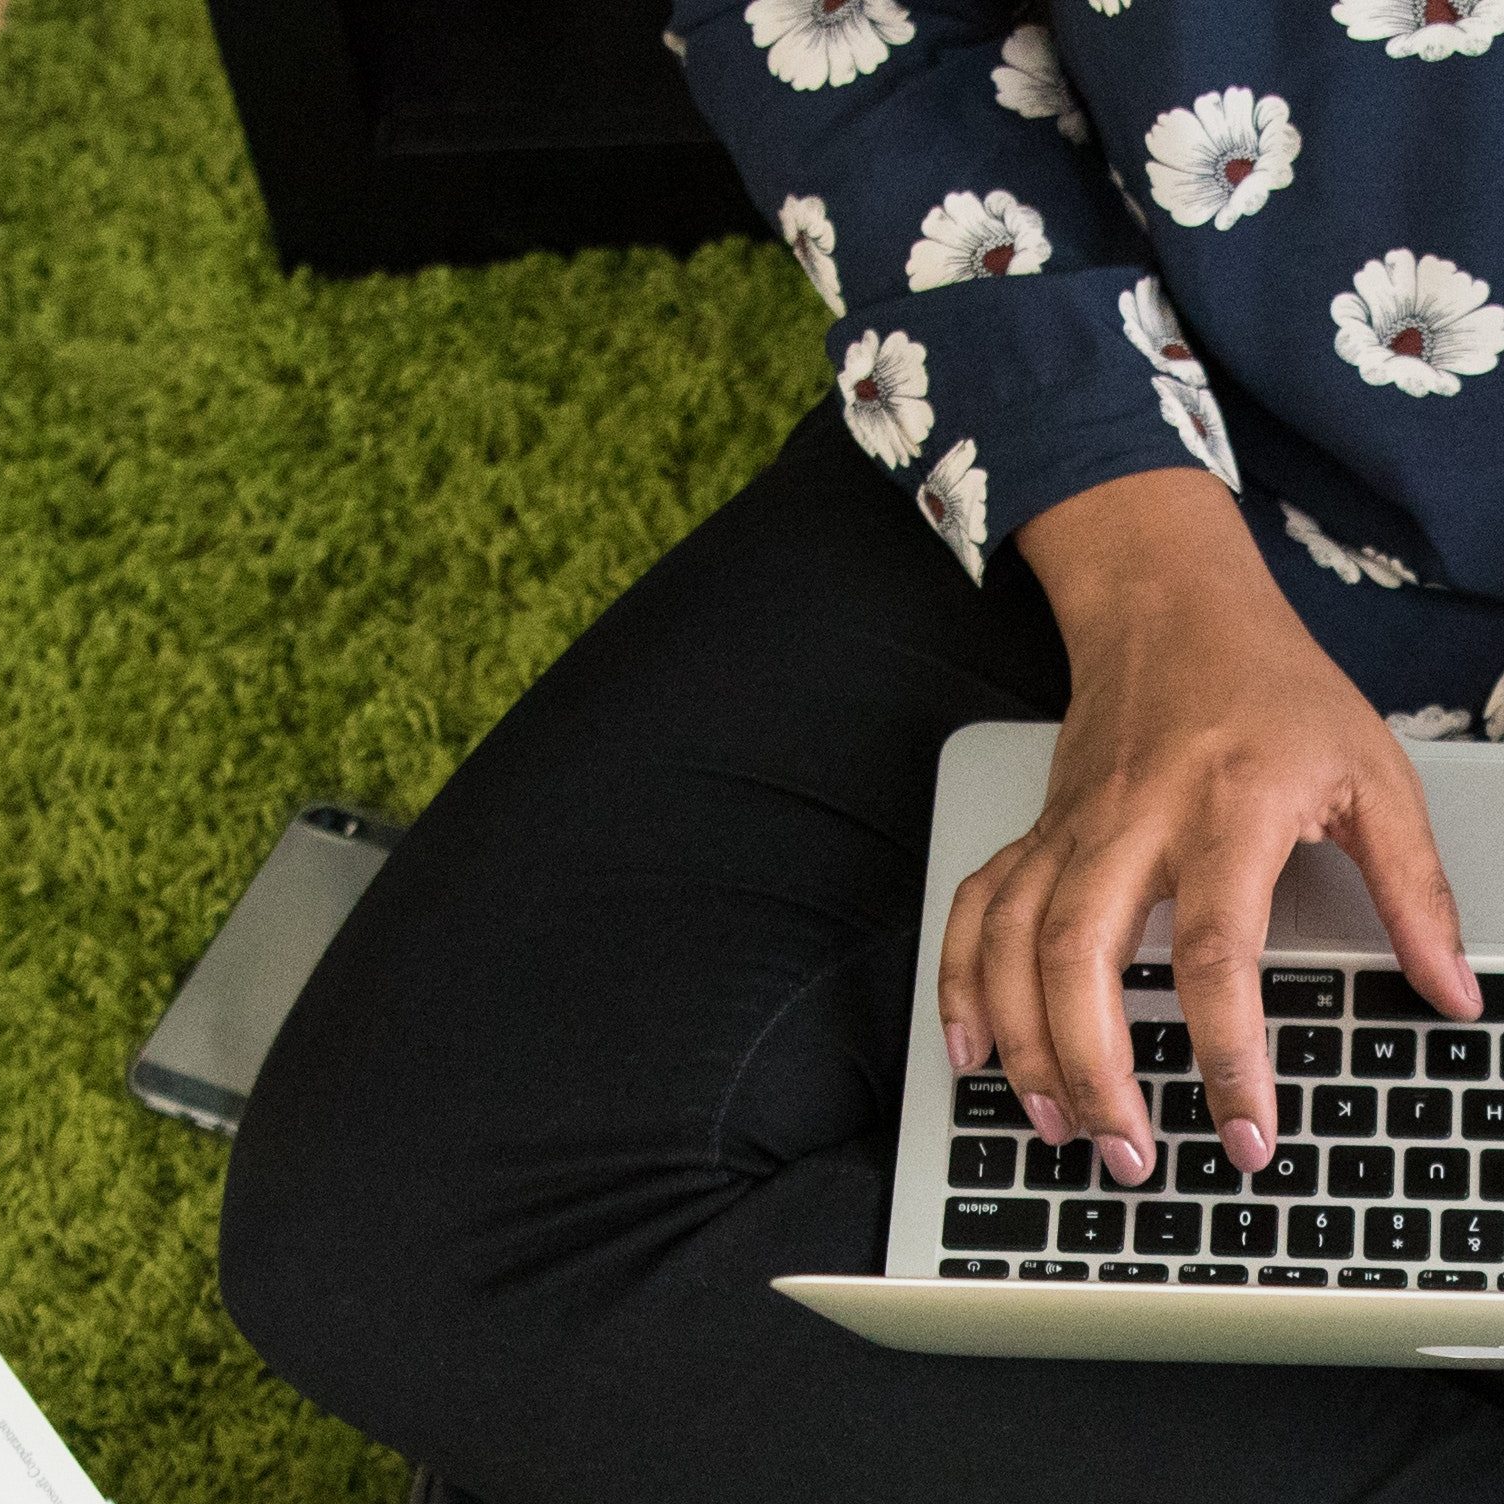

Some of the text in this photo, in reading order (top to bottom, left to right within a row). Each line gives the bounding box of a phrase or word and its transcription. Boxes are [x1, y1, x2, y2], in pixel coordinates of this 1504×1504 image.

[1270, 971, 1335, 984] command
[1373, 1042, 1394, 1059] M
[1449, 1043, 1466, 1060] N
[1337, 1100, 1352, 1117] K
[1485, 1104, 1502, 1121] H
[956, 1201, 998, 1215] delete
